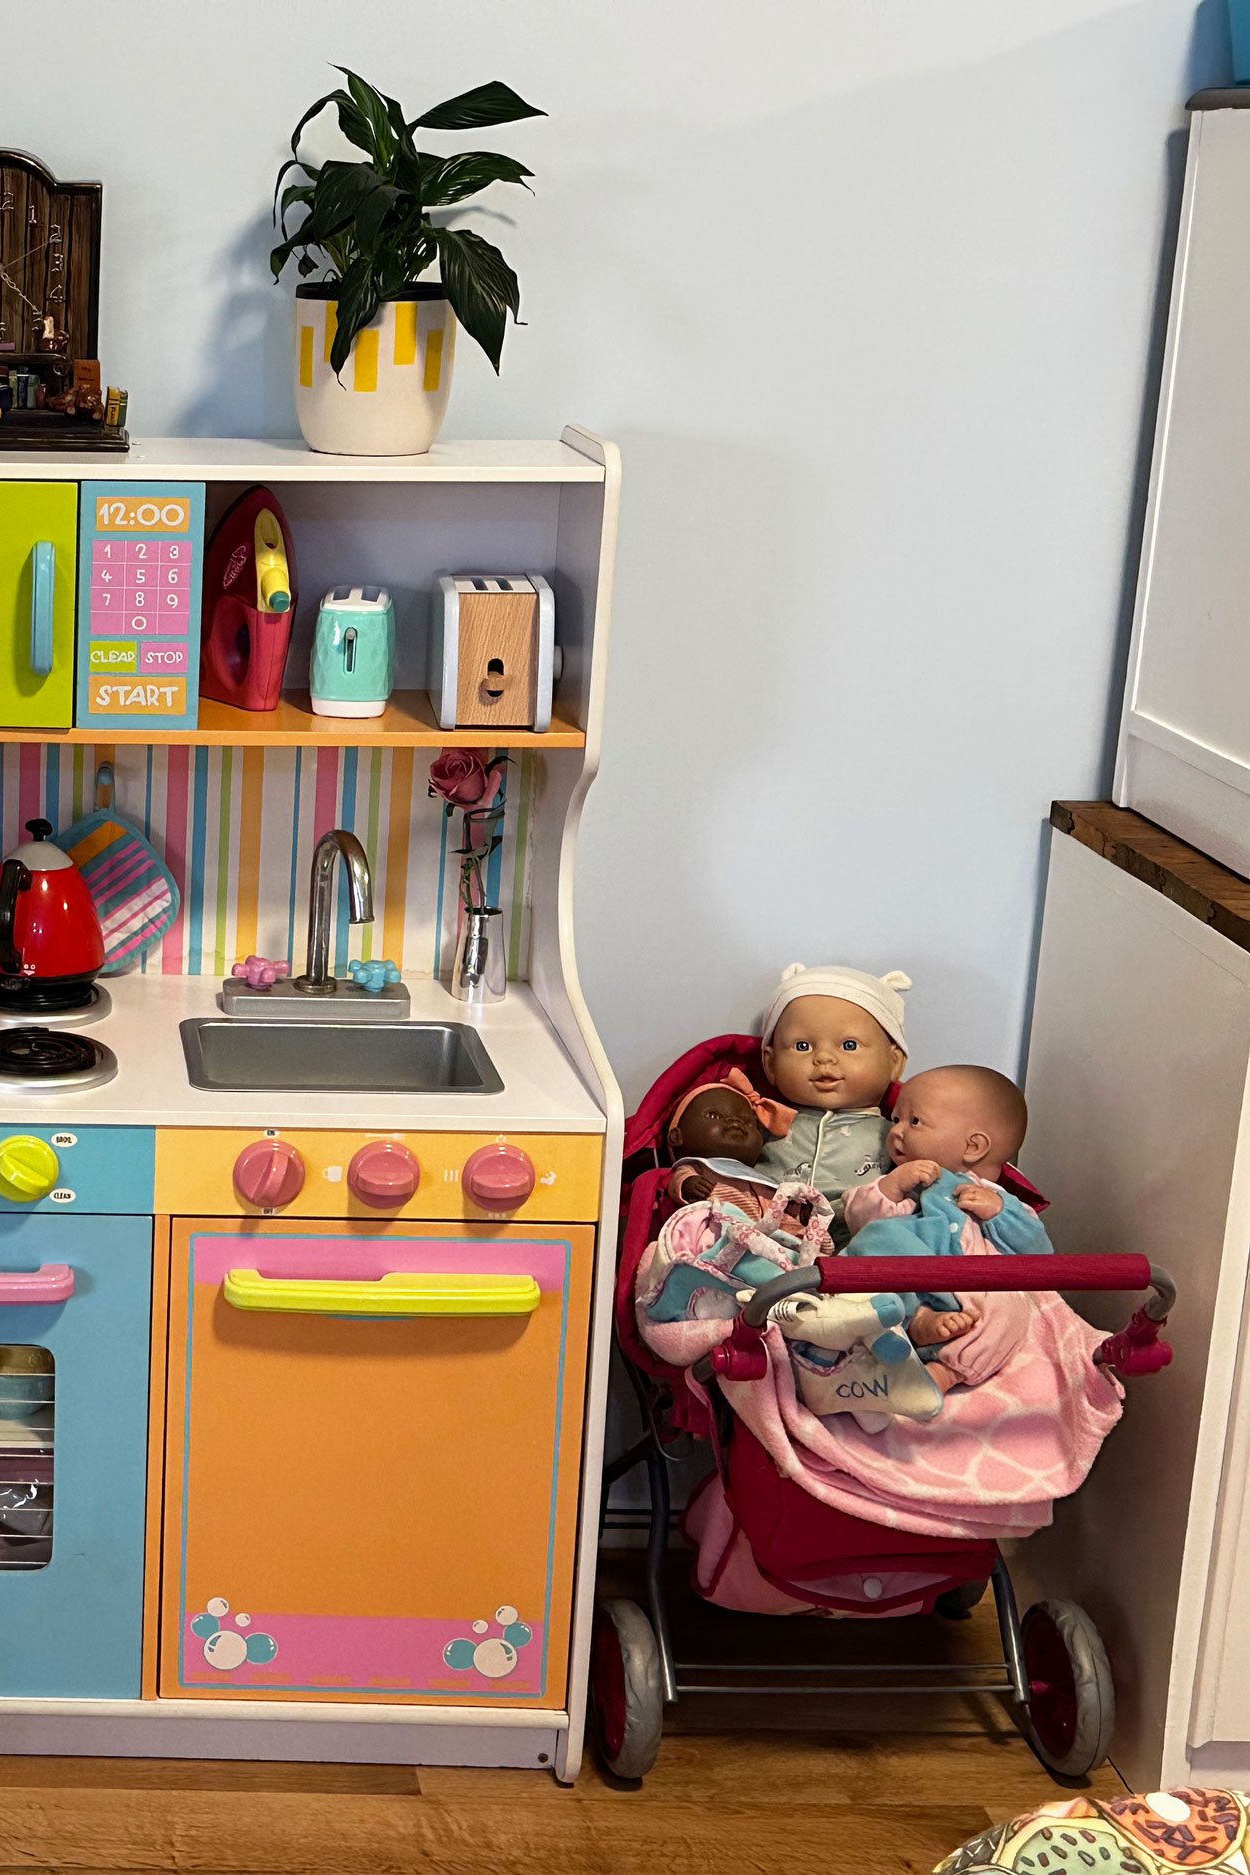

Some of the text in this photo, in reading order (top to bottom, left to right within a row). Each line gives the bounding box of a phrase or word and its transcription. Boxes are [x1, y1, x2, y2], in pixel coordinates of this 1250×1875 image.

[29, 205, 37, 223] 1
[50, 224, 62, 242] 2
[100, 503, 185, 526] 12:00
[104, 543, 179, 559] 1 2 3
[101, 569, 178, 584] 4 5 6
[102, 592, 178, 608] 7 8 9
[131, 616, 147, 631] 0
[90, 650, 136, 664] CLEAR
[145, 651, 183, 664] STOP
[96, 685, 178, 707] START
[835, 1374, 889, 1399] COW
